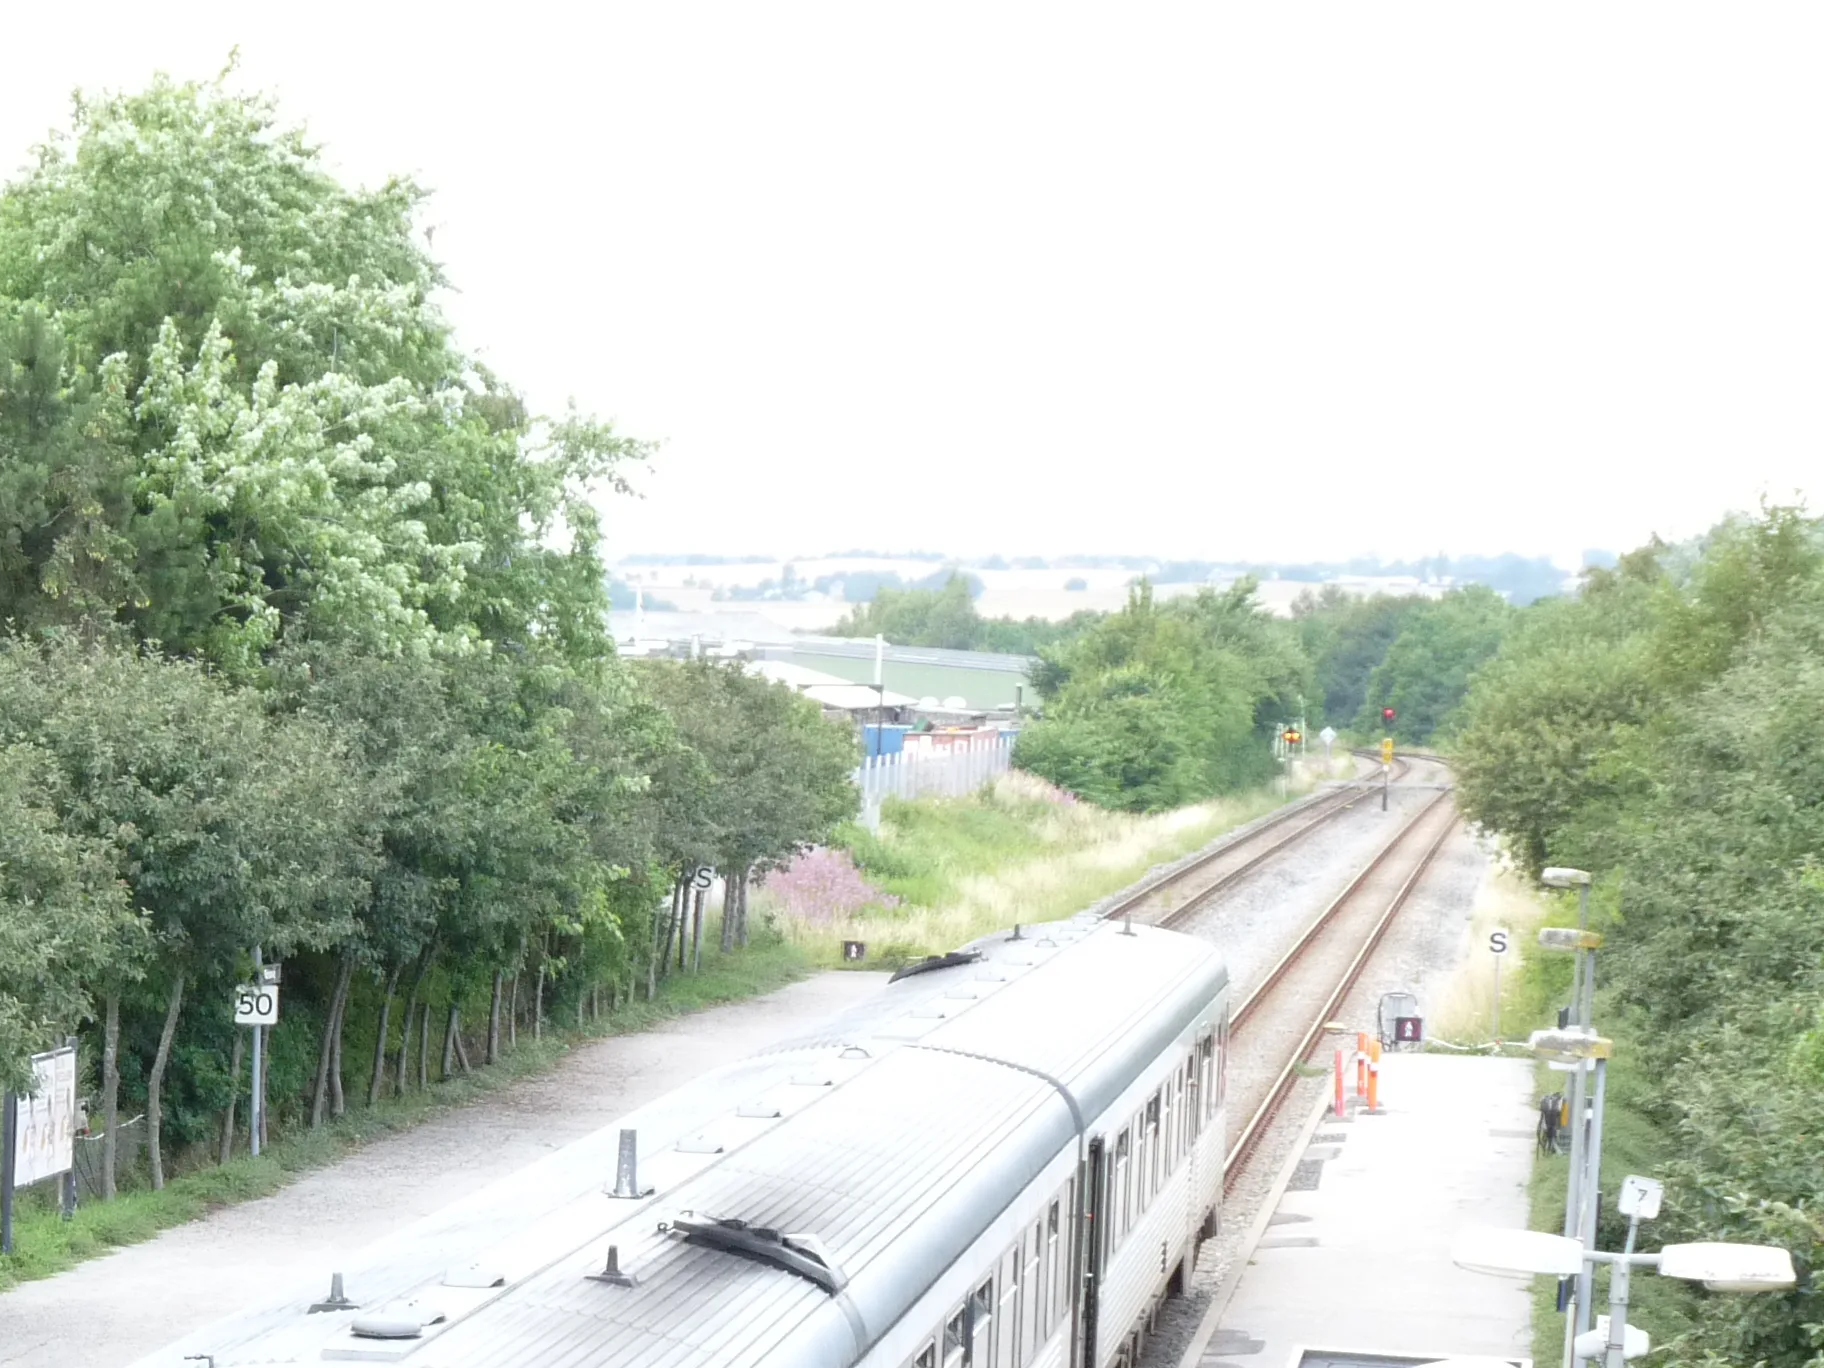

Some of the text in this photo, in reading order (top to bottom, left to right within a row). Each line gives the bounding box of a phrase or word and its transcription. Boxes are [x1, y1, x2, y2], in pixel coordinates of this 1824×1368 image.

[697, 868, 711, 888] S
[1489, 932, 1507, 953] S
[239, 993, 273, 1016] 50
